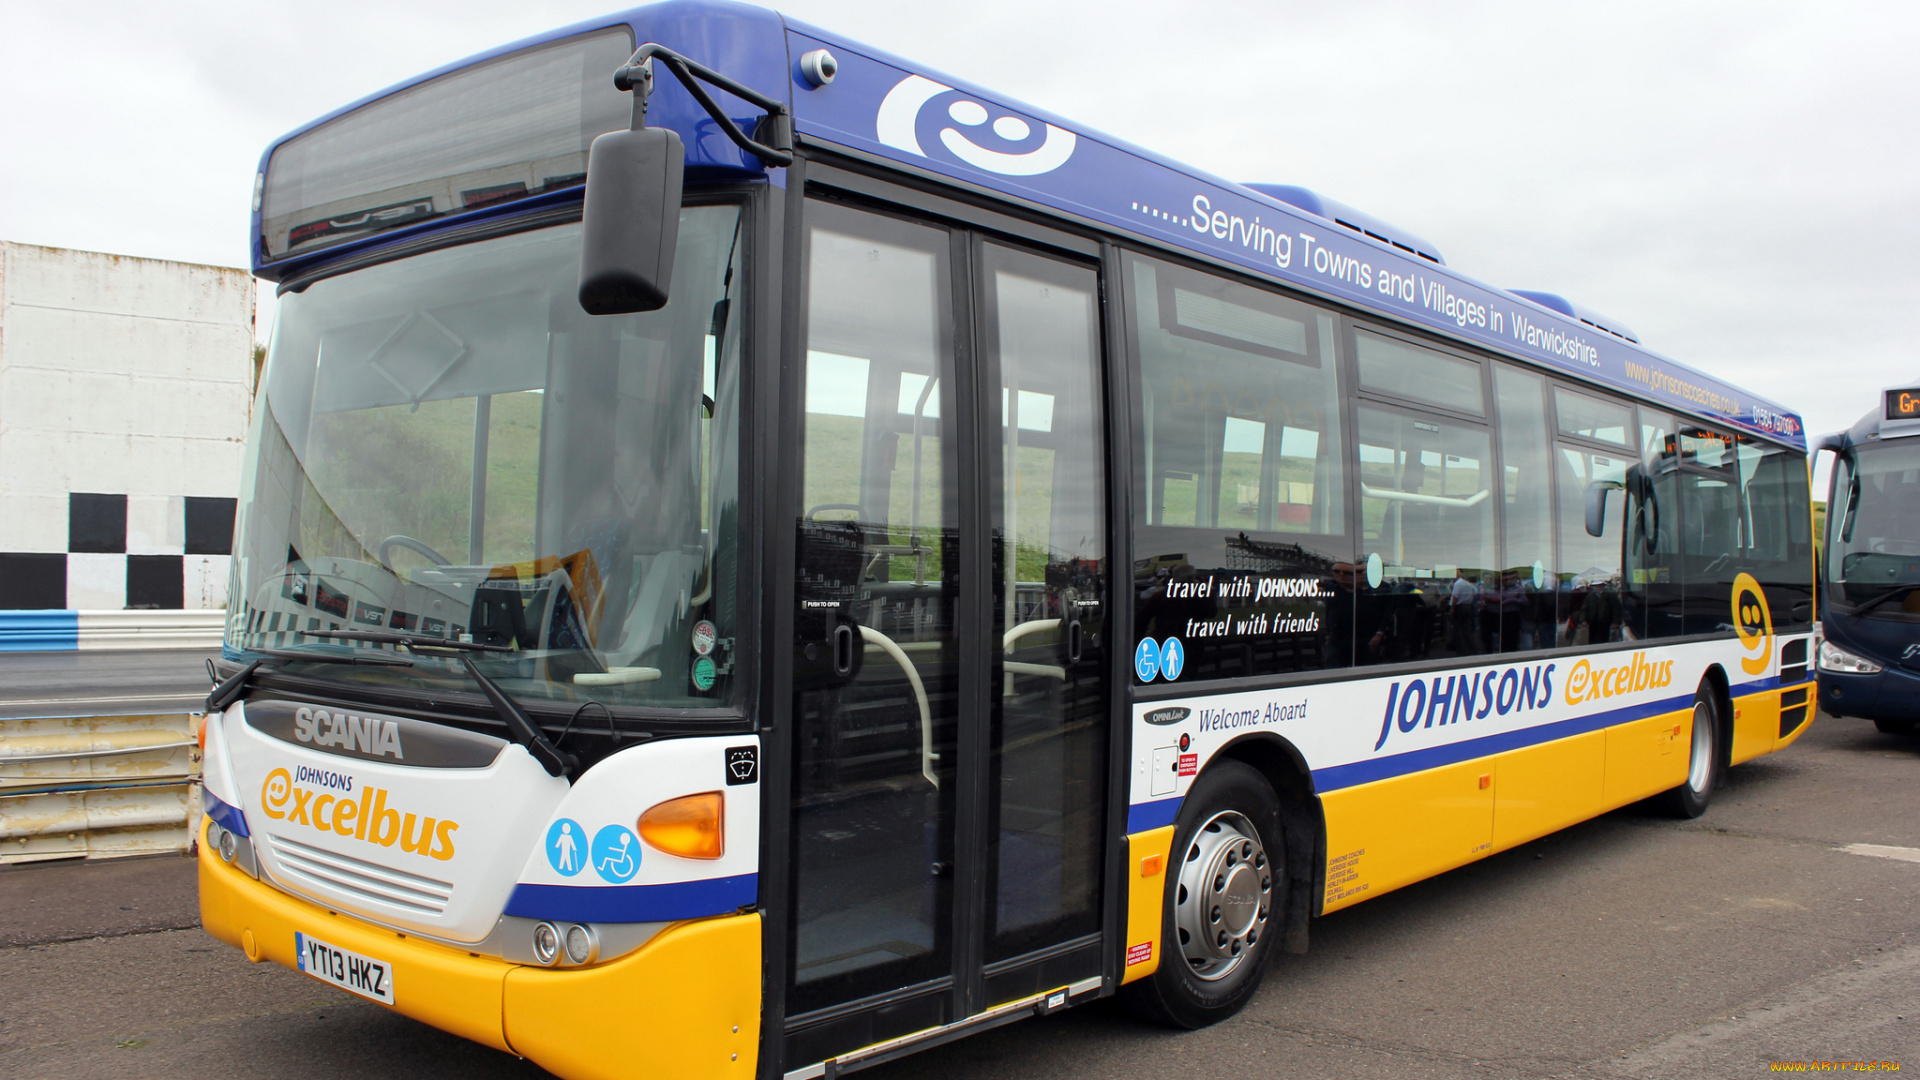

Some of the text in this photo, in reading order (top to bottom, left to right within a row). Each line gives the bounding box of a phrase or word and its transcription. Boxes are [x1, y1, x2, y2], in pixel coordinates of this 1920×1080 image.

[1299, 232, 1372, 289] Towns
[1378, 269, 1415, 303] and
[1420, 276, 1486, 327] Villages
[1490, 303, 1504, 334] in
[1511, 311, 1601, 367] Warwickshire.
[1624, 360, 1740, 416] www.johnsonscoaches.co.uk
[1166, 575, 1213, 598] travel
[1219, 576, 1251, 597] with
[1186, 611, 1320, 638] travel with friends
[294, 707, 404, 759] SCANIA
[1199, 698, 1307, 732] Welcome Aboard
[1374, 663, 1556, 752] JOHNSONS
[295, 764, 353, 792] JOHNSONS
[308, 940, 386, 996] YT13 HKZ
